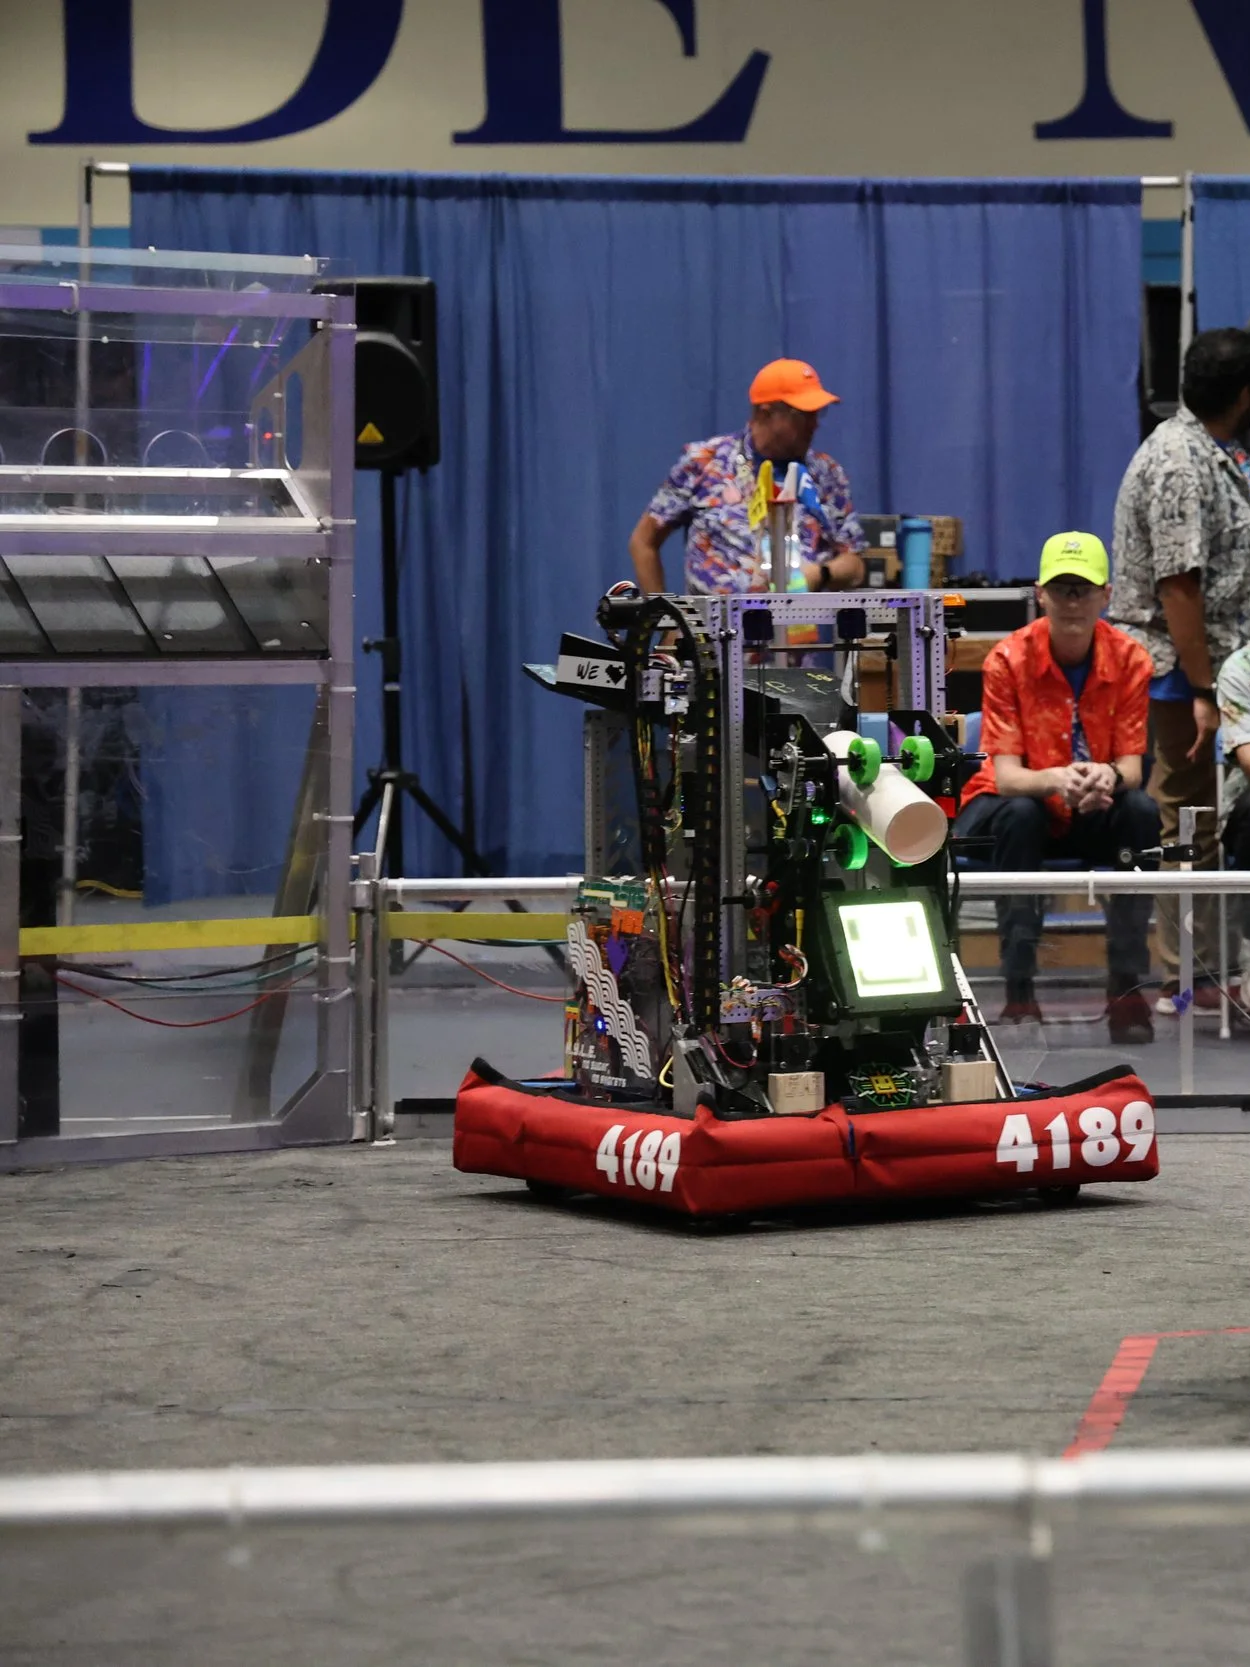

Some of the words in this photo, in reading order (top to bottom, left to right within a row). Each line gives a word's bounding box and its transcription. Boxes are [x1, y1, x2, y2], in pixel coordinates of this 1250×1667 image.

[576, 661, 600, 680] WE
[596, 1124, 680, 1192] 4189
[996, 1101, 1155, 1173] 4189
